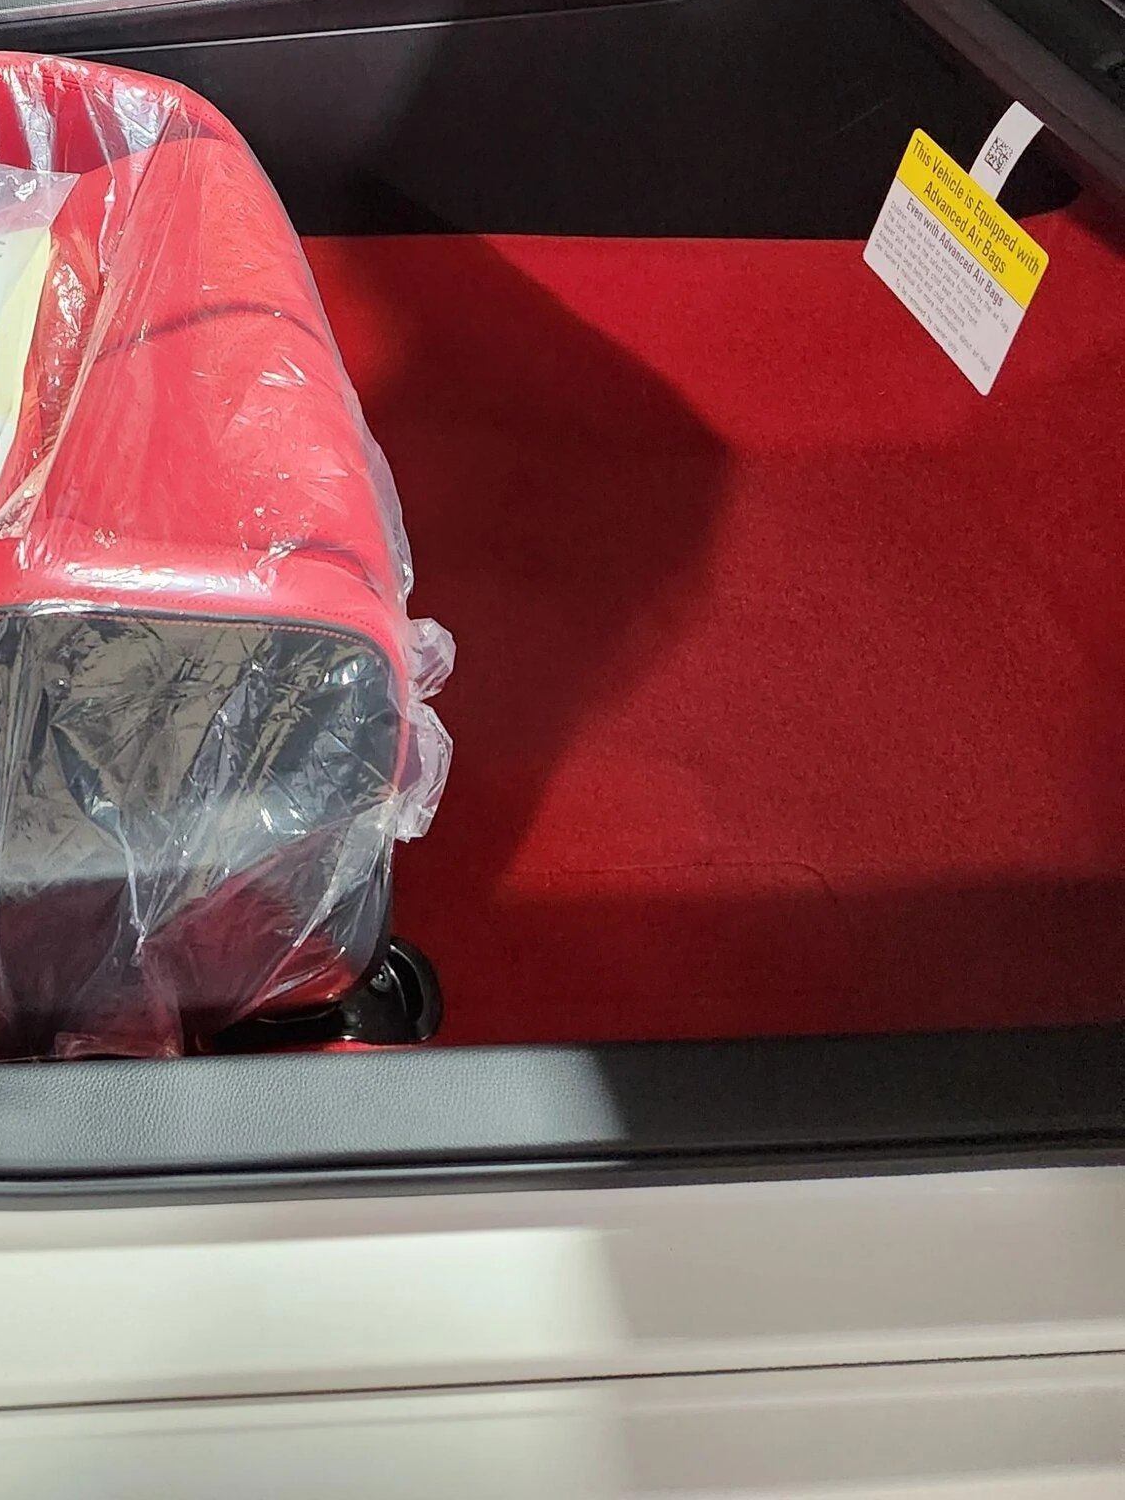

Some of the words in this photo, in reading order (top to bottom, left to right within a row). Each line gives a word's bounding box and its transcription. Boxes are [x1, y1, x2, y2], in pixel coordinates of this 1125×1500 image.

[906, 197, 924, 222] Even
[923, 217, 940, 239] with
[938, 232, 974, 274] Advanced
[972, 267, 985, 287] Air
[984, 279, 1004, 307] Bags
[912, 138, 933, 167] This
[930, 156, 966, 200] Vehicle
[963, 189, 976, 209] is
[972, 200, 1019, 256] Equipped
[1015, 245, 1041, 276] with
[923, 180, 969, 233] Advanced
[966, 223, 984, 249] Air
[981, 239, 1008, 278] Bags
